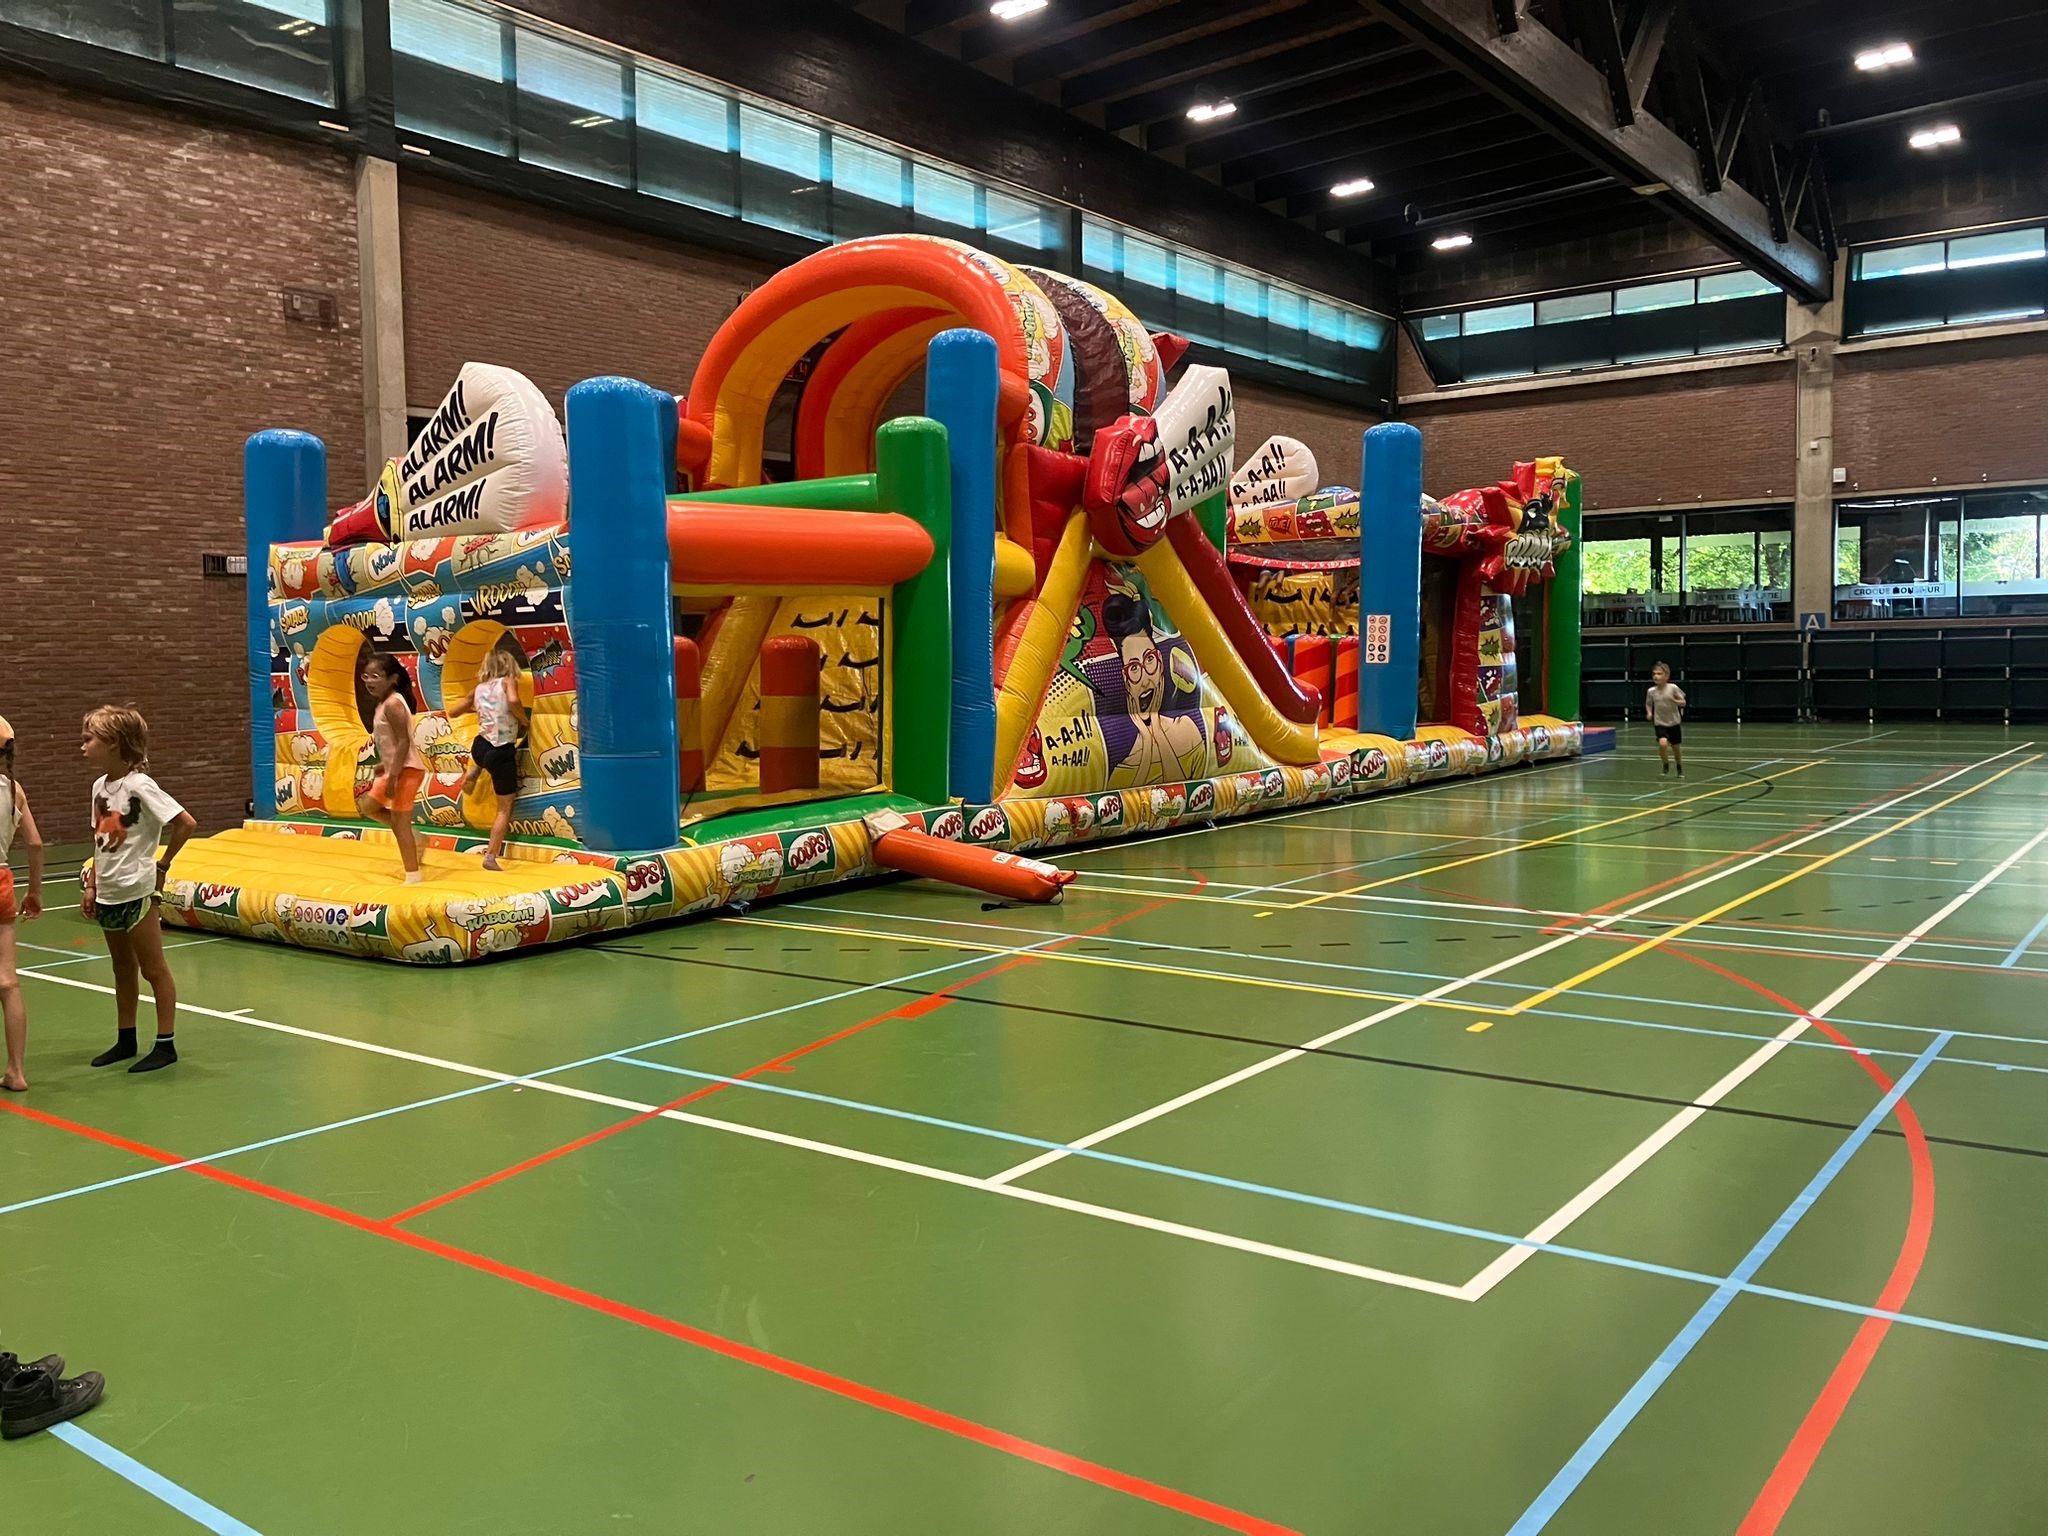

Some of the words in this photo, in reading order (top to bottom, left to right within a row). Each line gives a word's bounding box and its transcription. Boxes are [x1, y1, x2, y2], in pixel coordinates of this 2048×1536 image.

[402, 380, 471, 482] ALARM!
[408, 412, 499, 505] ALARM!
[1177, 452, 1227, 500] A-A-AA!!
[1233, 443, 1286, 498] A-A-A!!
[409, 478, 487, 531] ALARM!
[1892, 585, 1941, 596] MONUR
[281, 610, 310, 634] SMACK
[1804, 614, 1821, 630] A
[1045, 709, 1093, 751] A-A-A!!
[1052, 746, 1090, 767] A-A-AA!!
[791, 832, 831, 870] OOOPS!
[467, 906, 535, 932] KABOOM!
